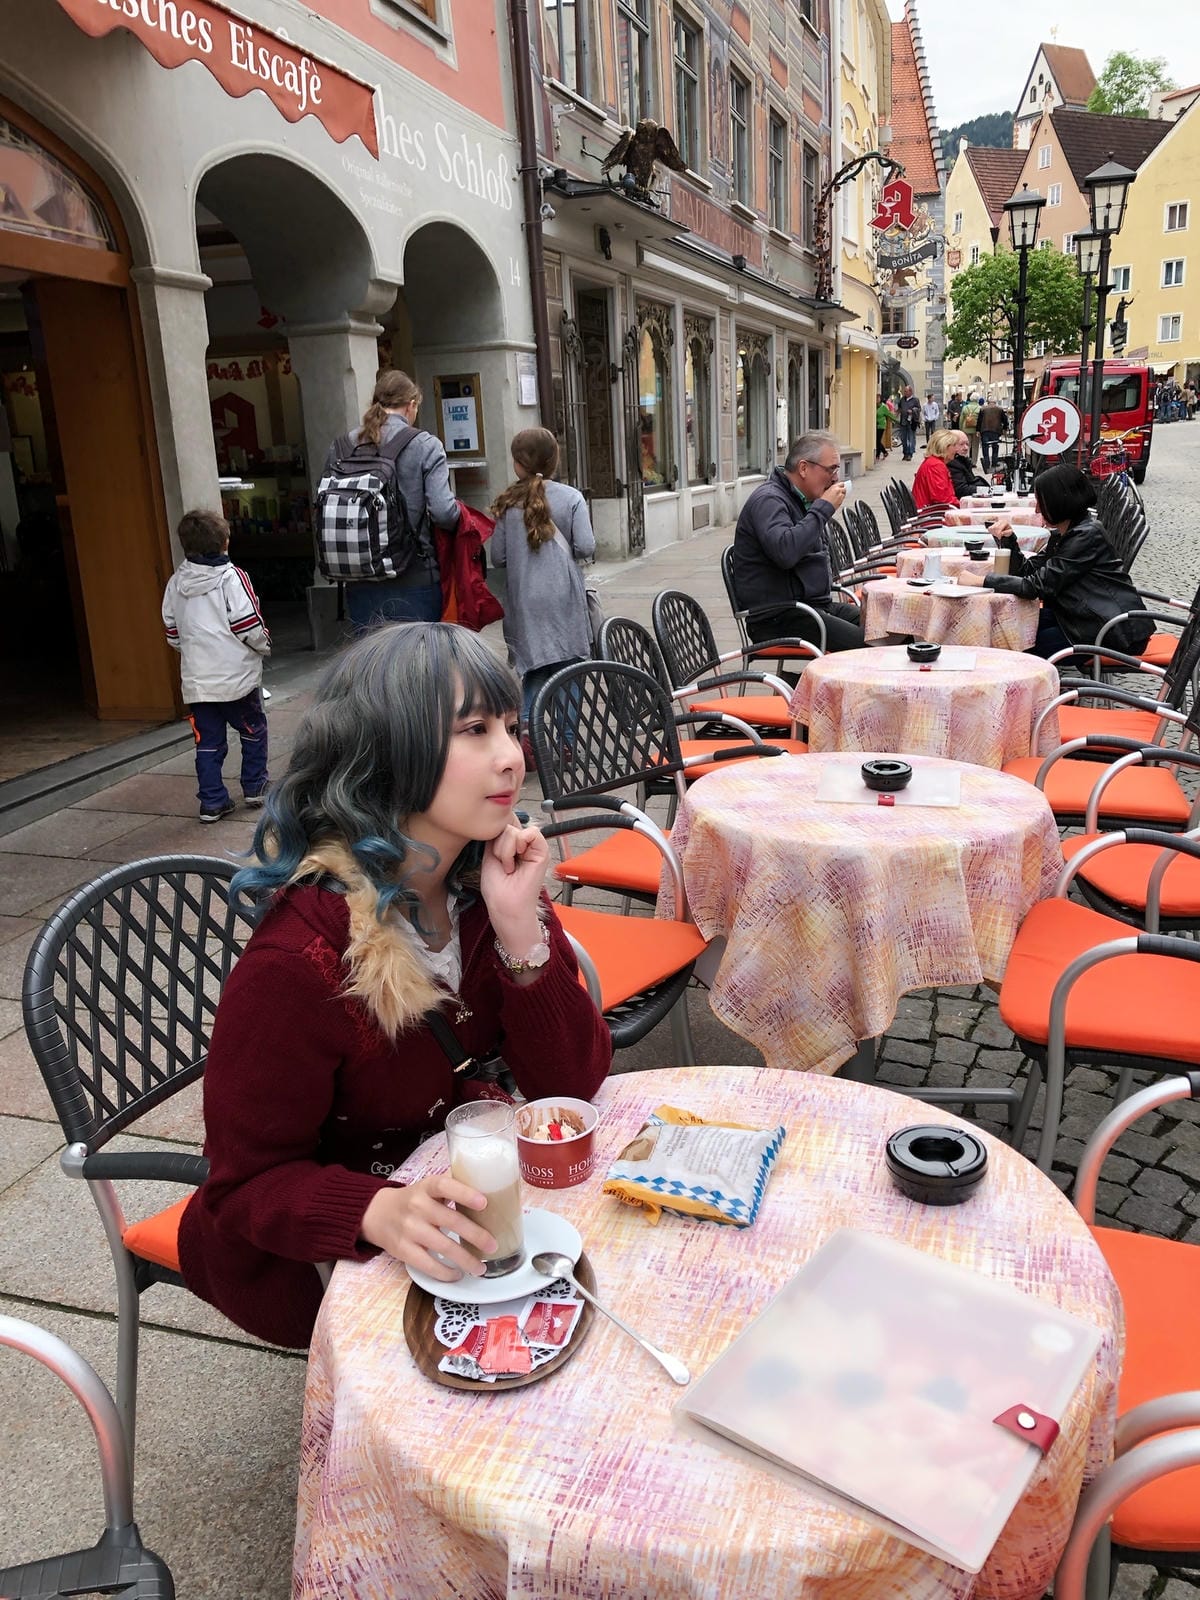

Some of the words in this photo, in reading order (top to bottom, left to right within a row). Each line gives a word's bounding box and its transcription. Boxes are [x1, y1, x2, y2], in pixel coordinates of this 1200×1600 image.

[99, 0, 213, 53] sches
[434, 121, 513, 211] Schloß
[509, 256, 521, 288] 14
[891, 252, 922, 268] BONITA
[448, 405, 469, 414] LUCKY
